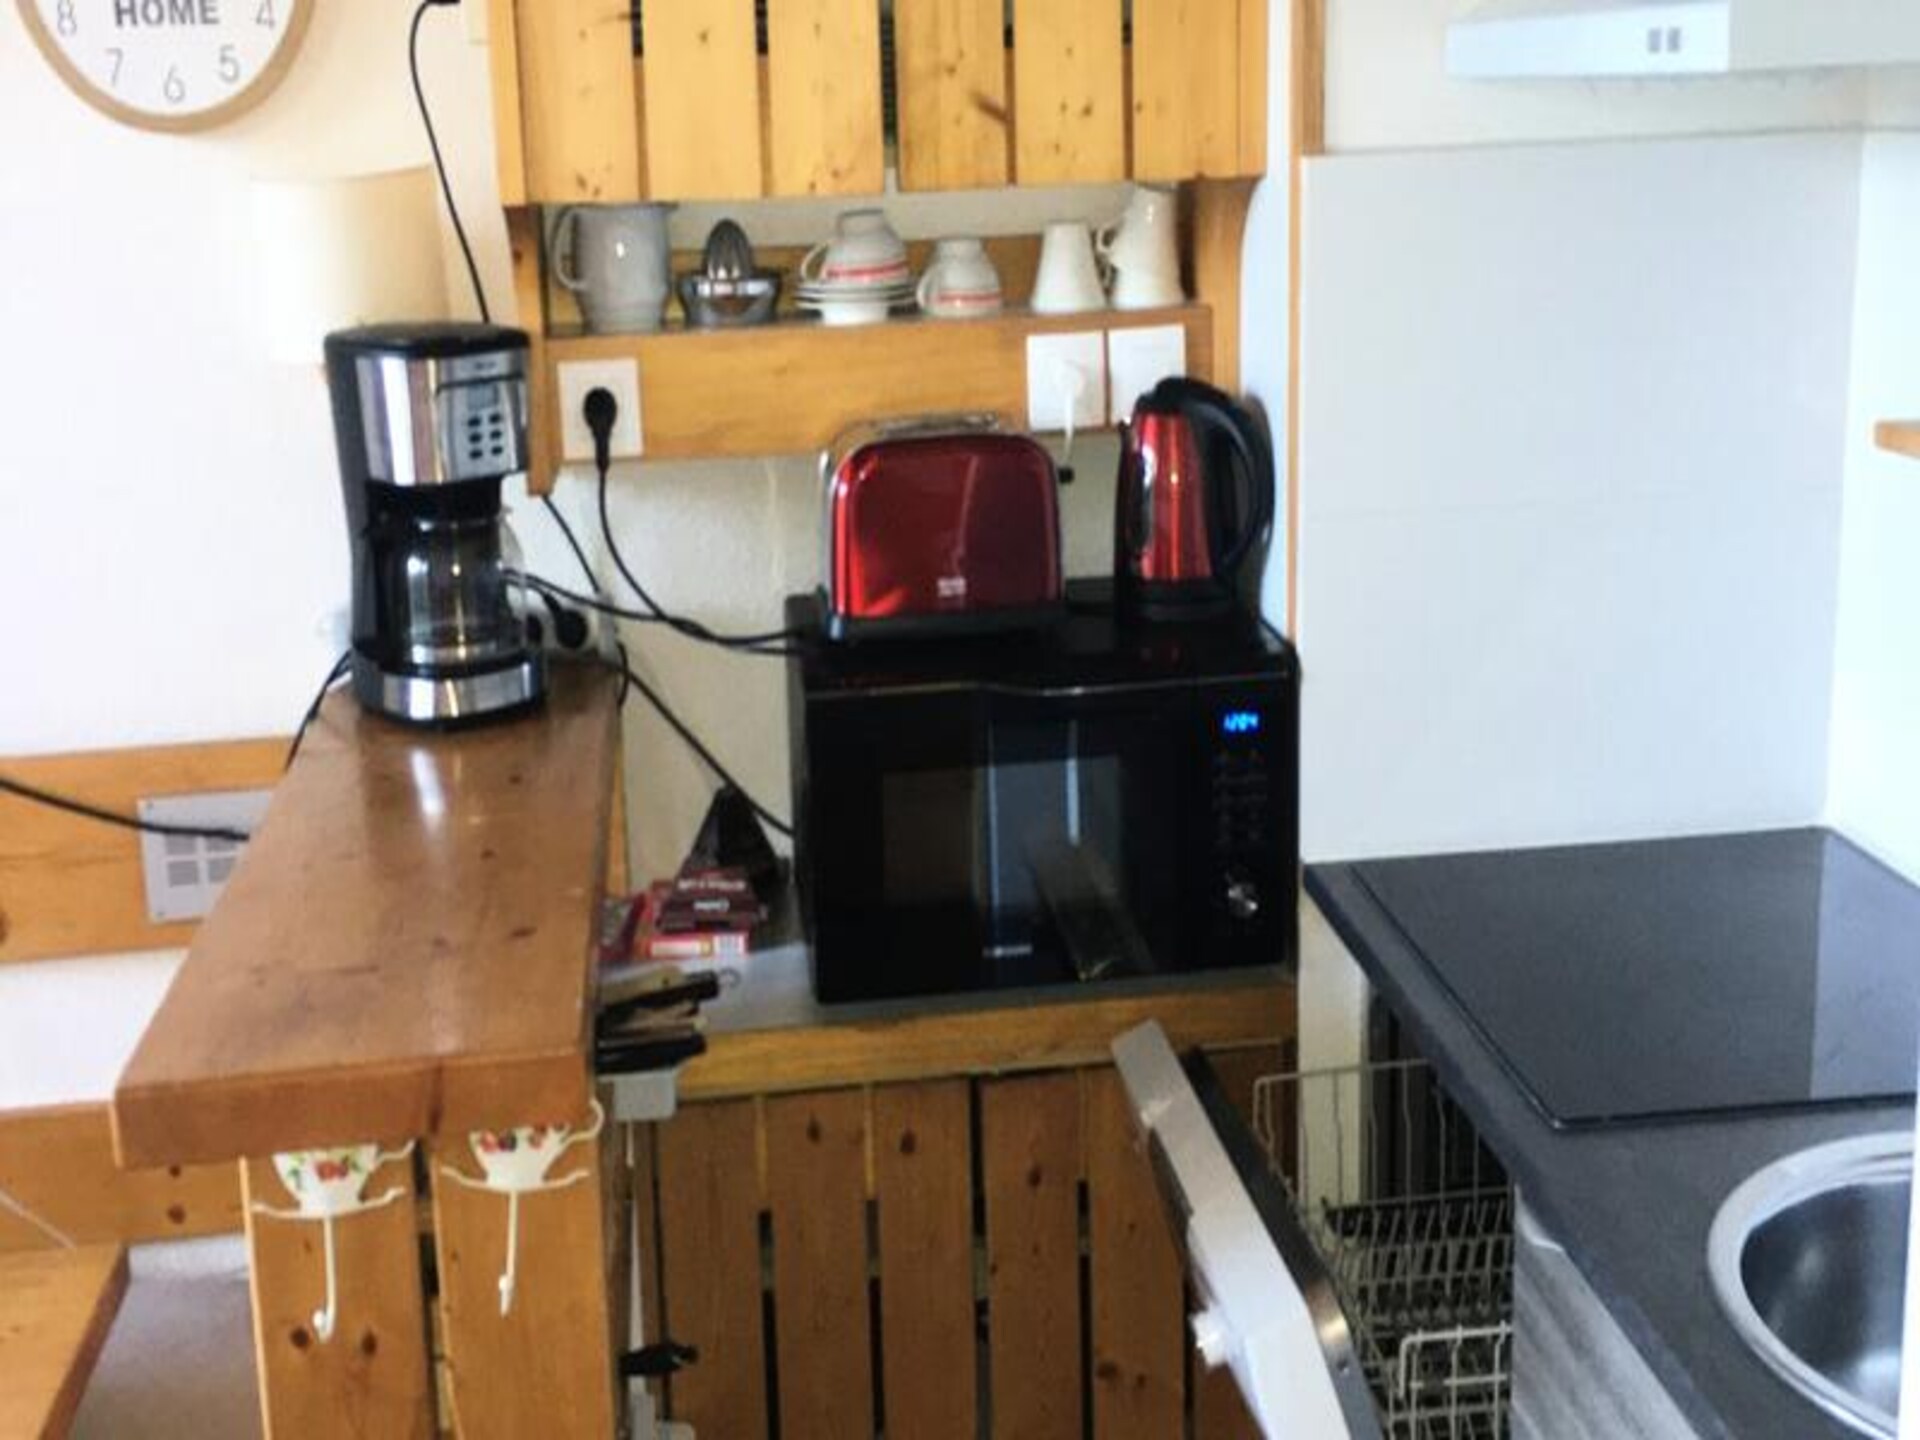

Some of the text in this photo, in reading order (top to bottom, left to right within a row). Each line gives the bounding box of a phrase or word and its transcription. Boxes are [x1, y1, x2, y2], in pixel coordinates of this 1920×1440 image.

[57, 0, 77, 37] 8
[114, 0, 220, 26] HOME
[256, 0, 275, 29] 4
[106, 48, 123, 86] 7
[219, 45, 239, 83] 5
[163, 64, 185, 103] 6
